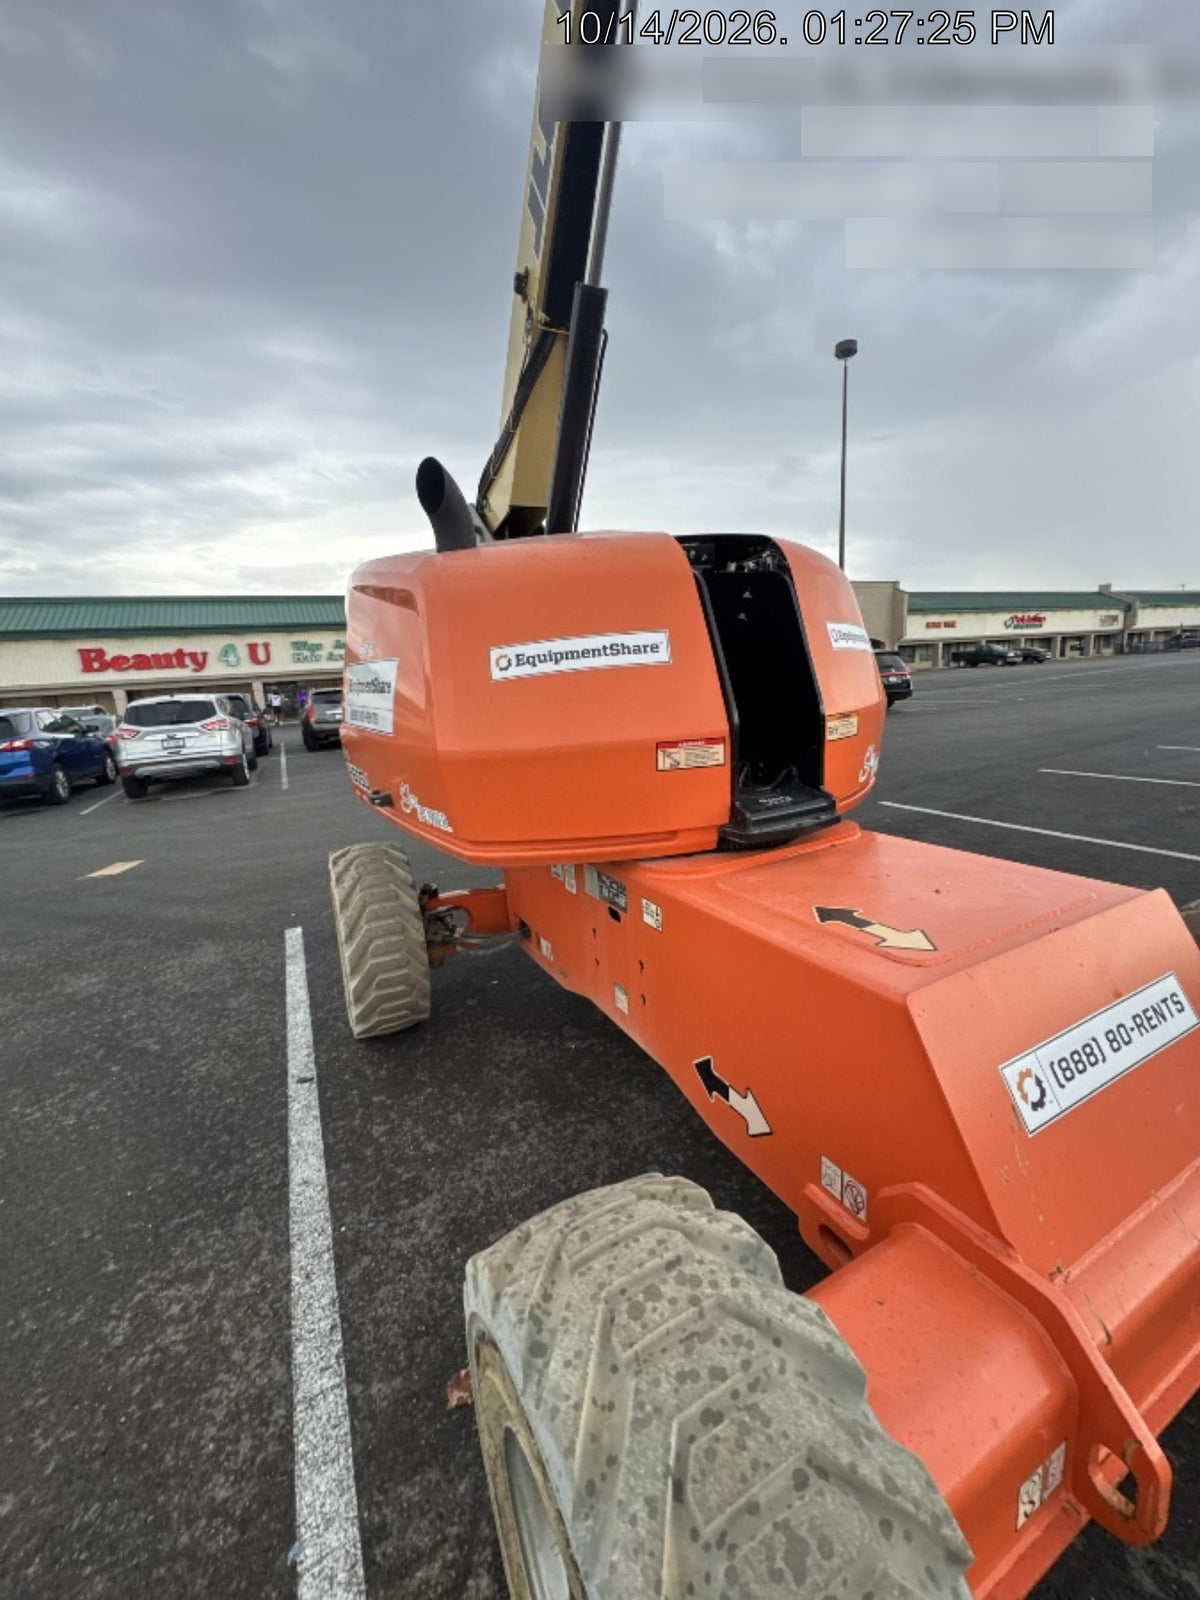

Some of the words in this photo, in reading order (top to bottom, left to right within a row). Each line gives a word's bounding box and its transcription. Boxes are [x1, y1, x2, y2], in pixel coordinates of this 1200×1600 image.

[77, 648, 208, 673] Beauty
[218, 643, 241, 667] 4
[246, 642, 272, 666] U
[514, 641, 661, 671] EquipmentShare
[1049, 1037, 1107, 1089] (888)
[1105, 992, 1186, 1054] 80-RENTS
